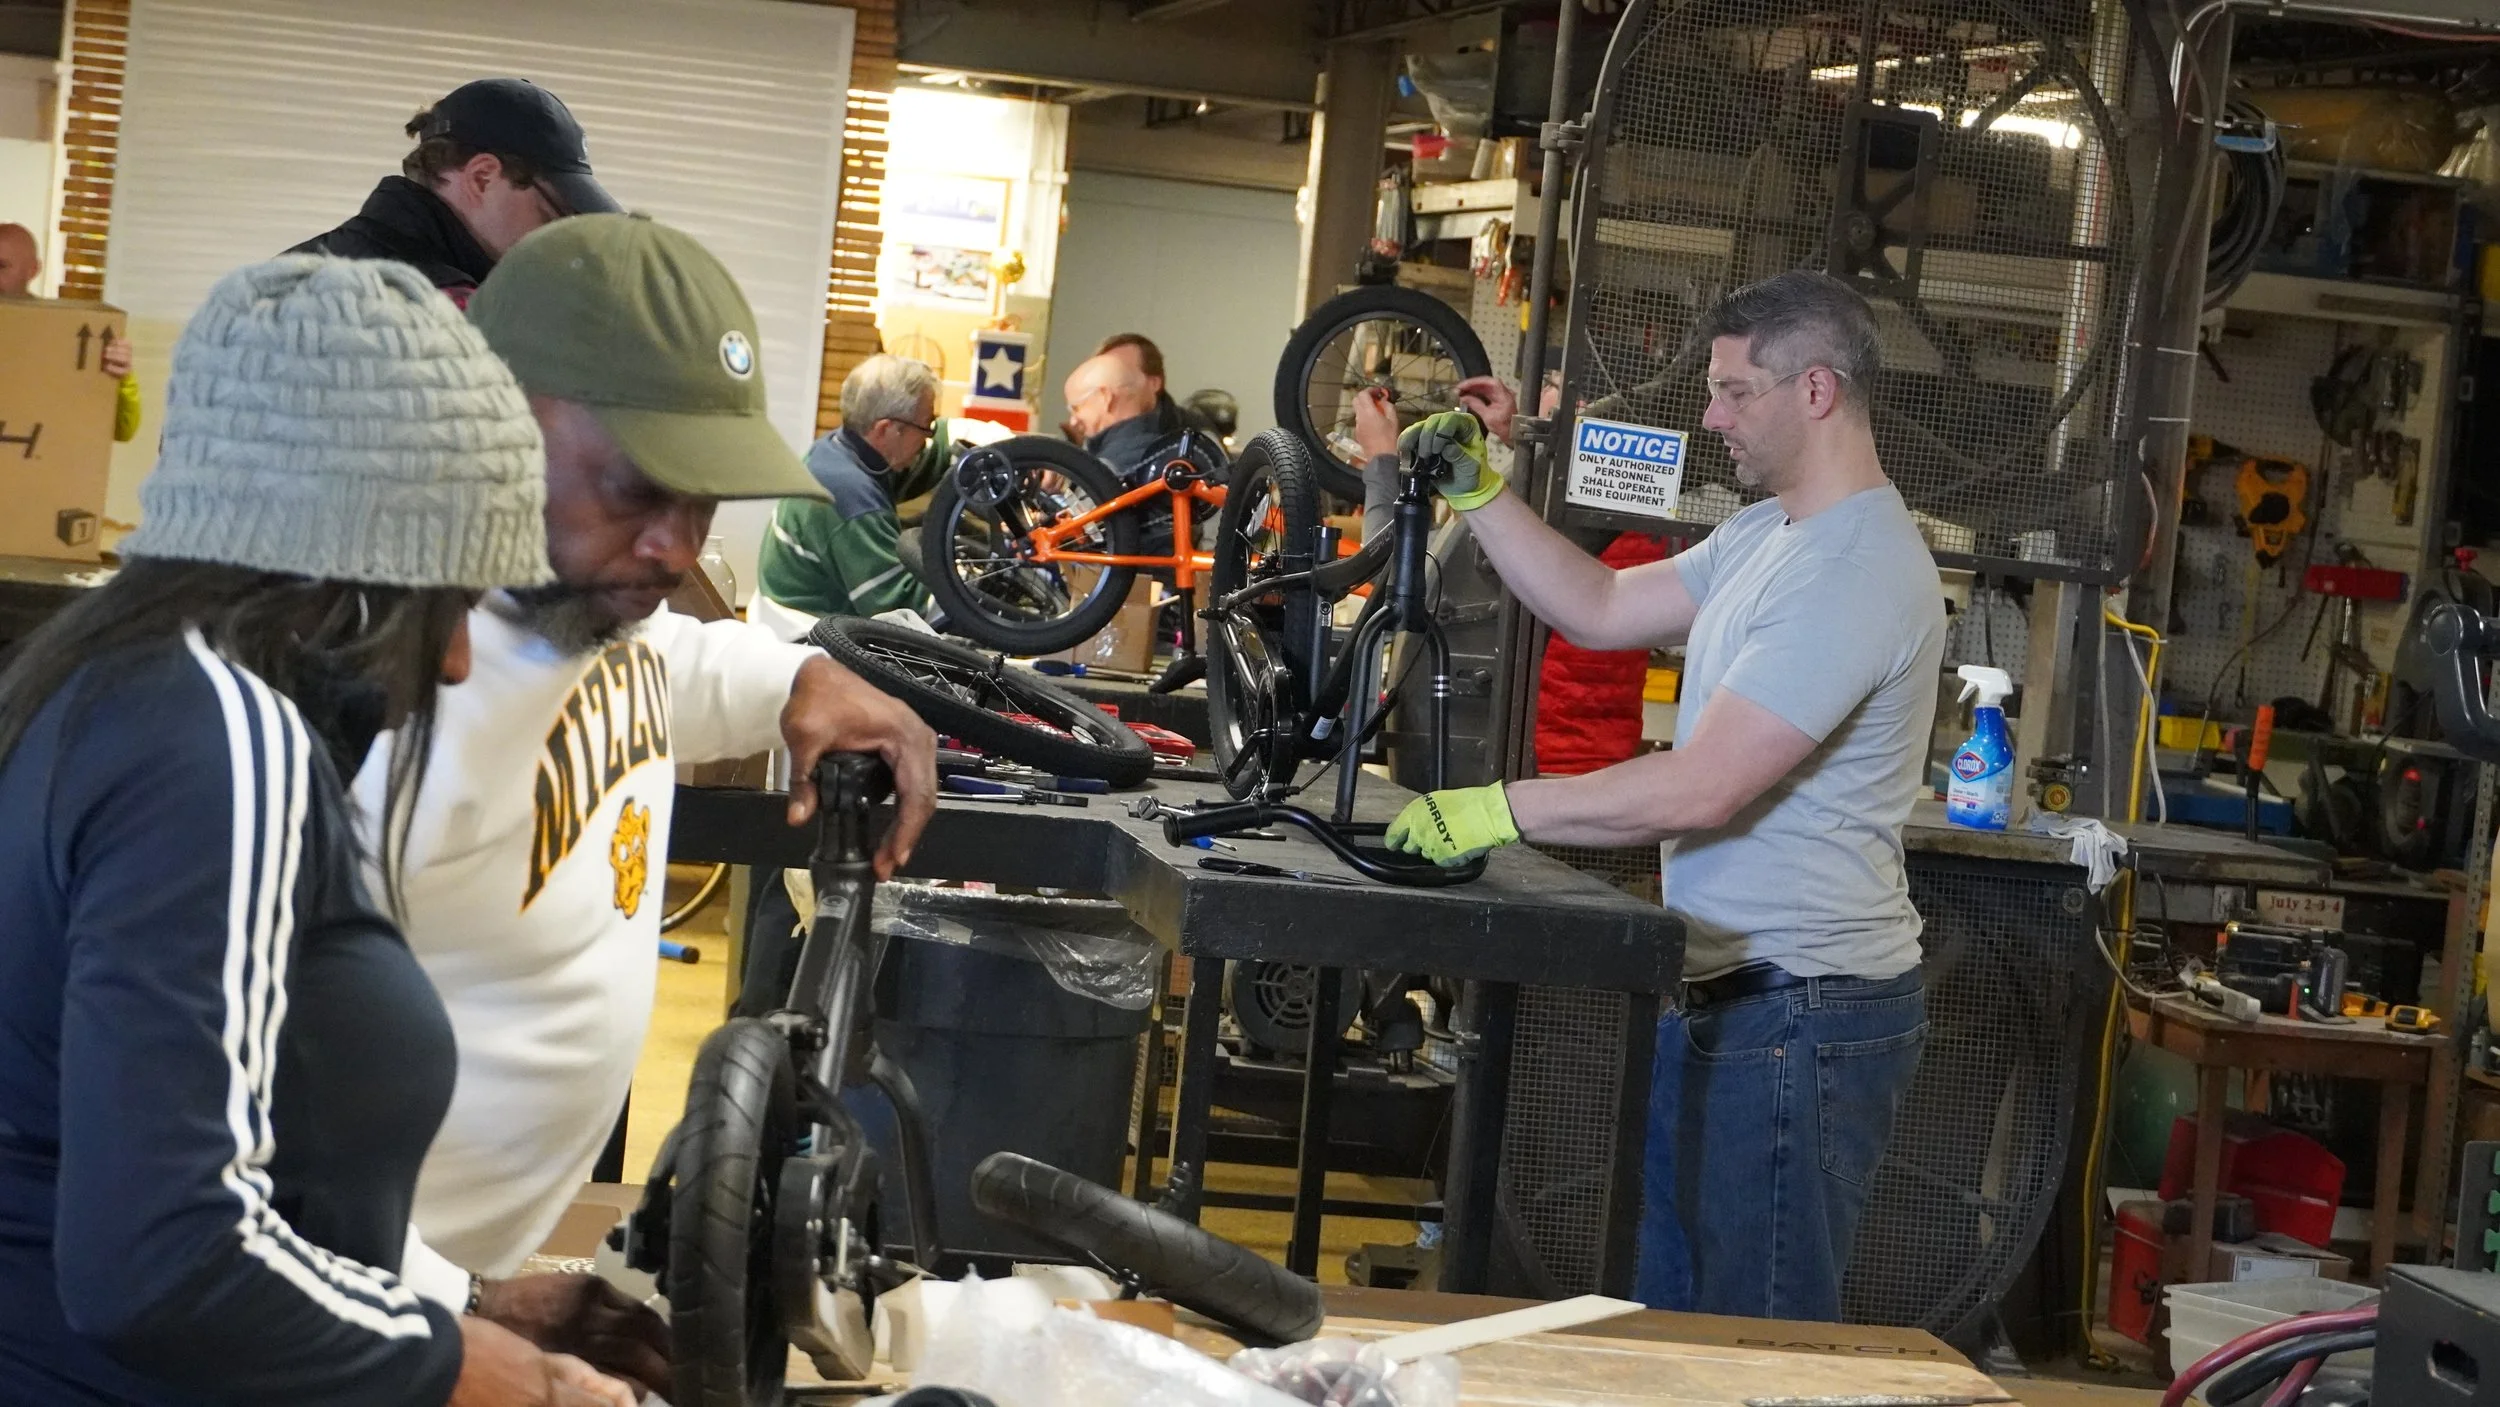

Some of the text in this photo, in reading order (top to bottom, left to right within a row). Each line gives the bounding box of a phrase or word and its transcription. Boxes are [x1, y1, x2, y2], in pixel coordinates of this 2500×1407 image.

[1583, 428, 1678, 460] NOTICE
[1579, 453, 1675, 476] ONLY AUTHORIZED
[1594, 466, 1656, 484] PERSONNEL
[1578, 485, 1666, 507] THIS EQUIPMENT
[1582, 475, 1665, 496] SHALL OPERATE
[1957, 758, 1981, 773] CLOROX
[520, 641, 668, 912] MIZZO
[2270, 895, 2300, 911] July
[1737, 1338, 1938, 1356] BATCH
